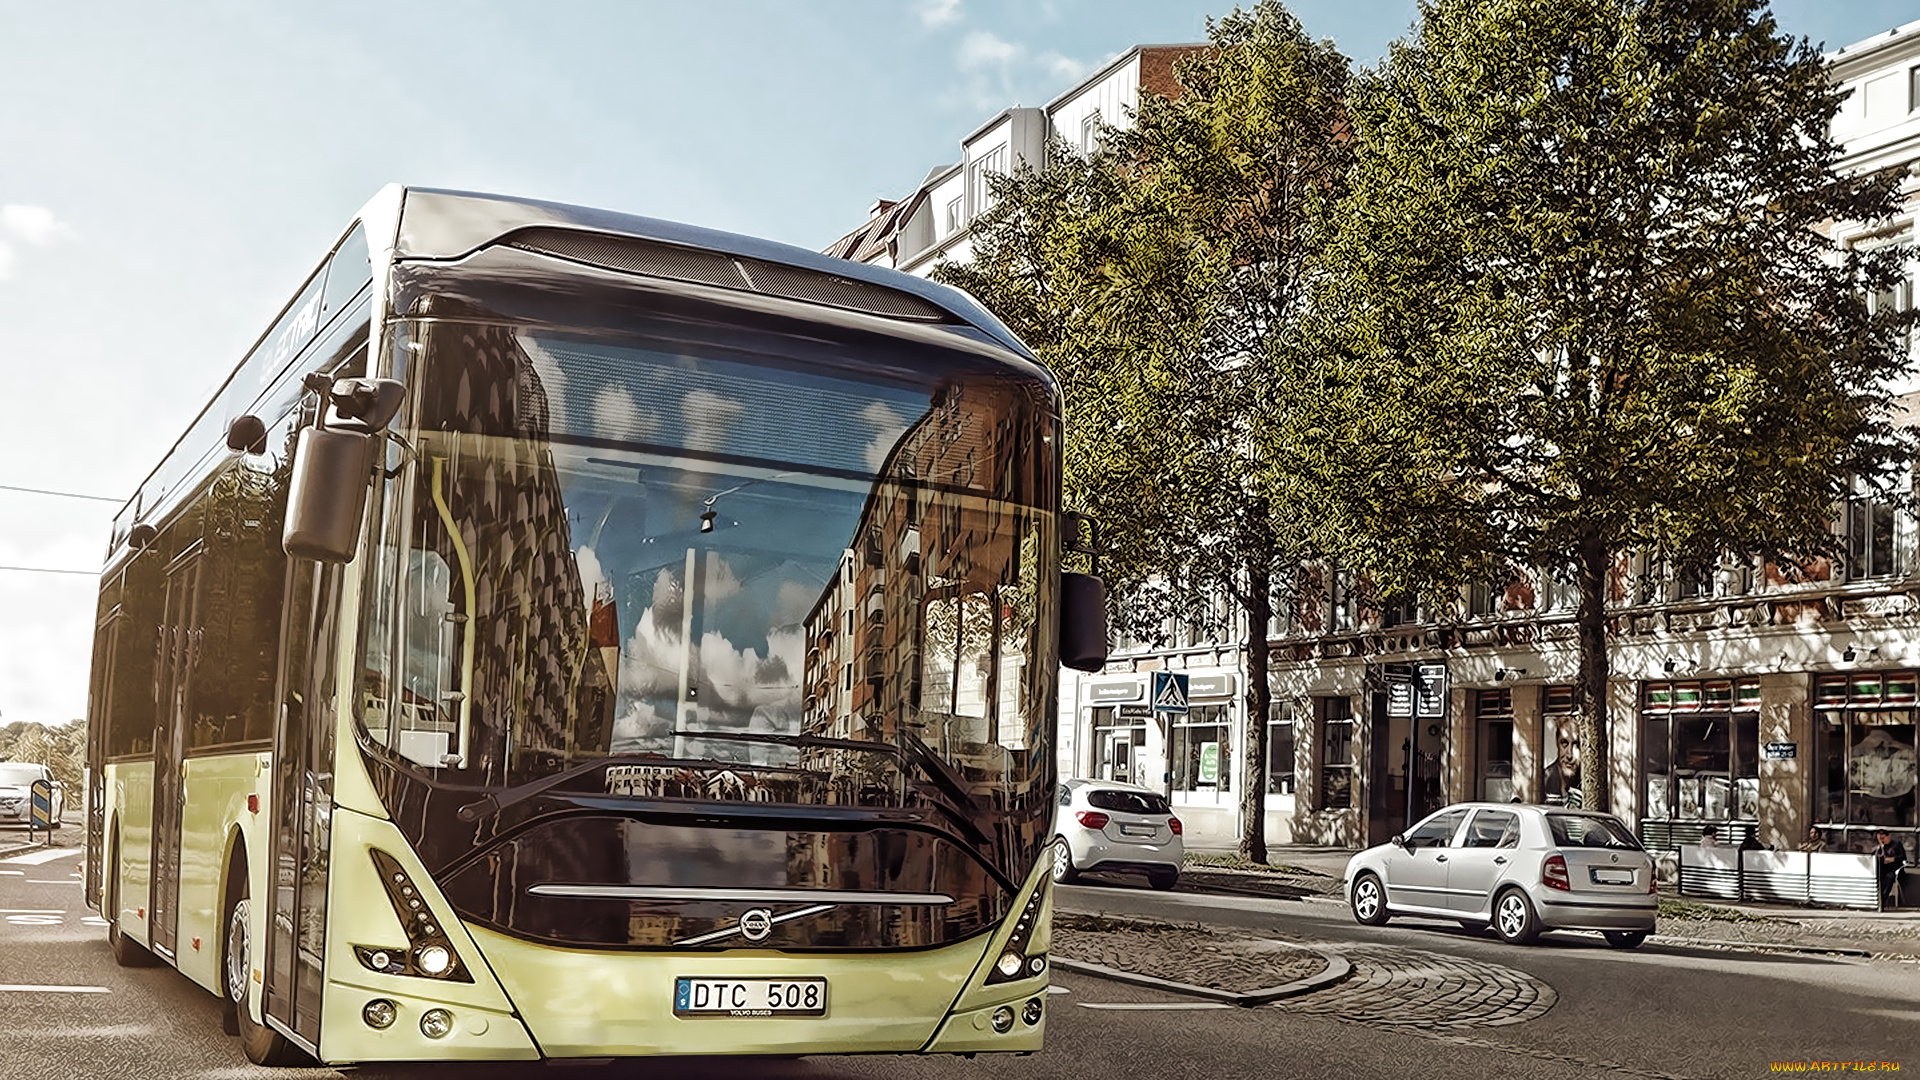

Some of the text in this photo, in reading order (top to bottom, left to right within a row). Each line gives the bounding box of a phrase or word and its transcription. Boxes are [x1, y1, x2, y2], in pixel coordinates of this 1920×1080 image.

[680, 998, 686, 1006] S
[694, 984, 818, 1008] DTC 508
